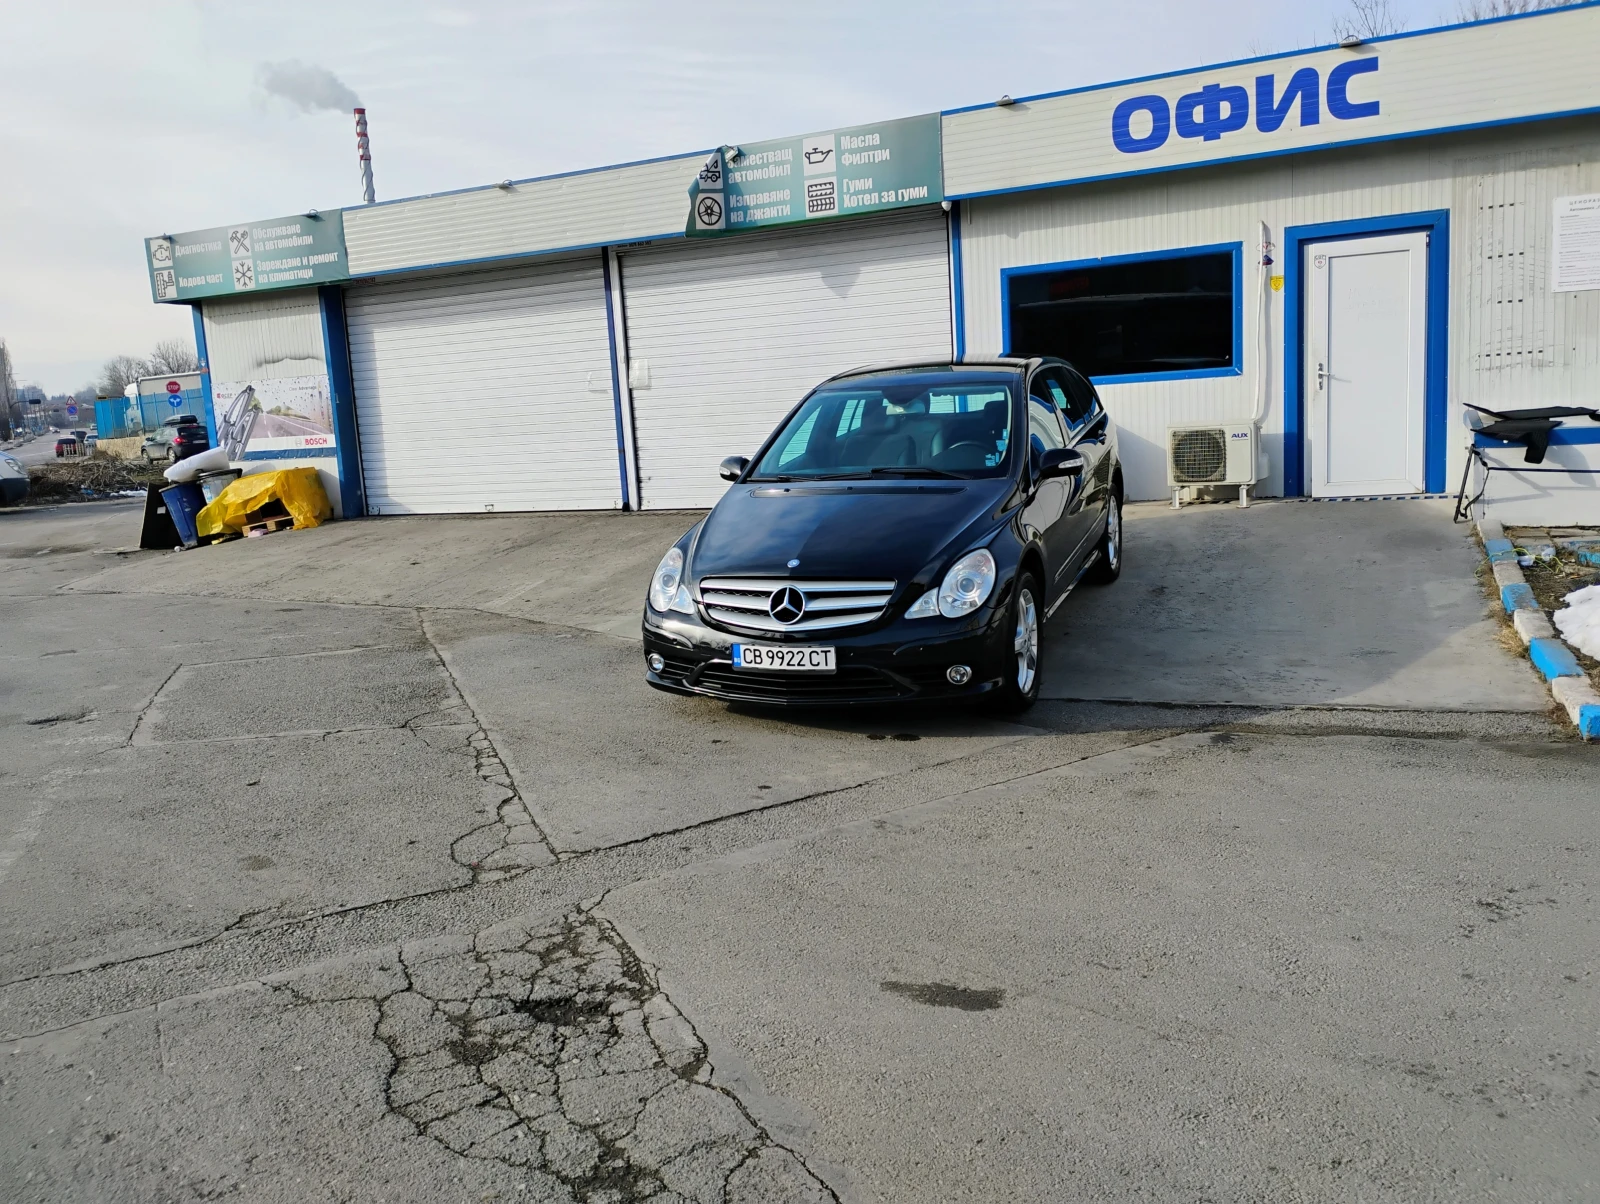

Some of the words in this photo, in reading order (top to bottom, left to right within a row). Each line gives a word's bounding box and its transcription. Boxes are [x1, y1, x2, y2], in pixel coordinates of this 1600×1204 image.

[1112, 56, 1380, 154] ОФИС
[840, 133, 880, 150] Масла
[841, 147, 890, 167] Филтри
[728, 163, 791, 184] автомобил
[842, 177, 873, 193] Гуми
[729, 188, 791, 208] Изправяне
[843, 192, 879, 208] Хотел
[881, 191, 896, 204] за
[897, 186, 928, 202] гуми
[730, 210, 745, 223] на
[746, 204, 791, 222] джанти
[253, 224, 301, 239] Обслужване
[175, 241, 222, 257] Диагностика
[254, 242, 263, 252] на
[264, 234, 313, 250] автомобили
[256, 257, 301, 272] Зареждане
[302, 257, 308, 266] и
[308, 251, 339, 267] ремонт
[178, 274, 206, 288] Ходова
[206, 272, 223, 284] част
[258, 273, 268, 284] на
[268, 268, 314, 283] климатици
[304, 437, 328, 446] BOSCH
[743, 648, 763, 664] CB
[766, 649, 806, 667] 9922
[809, 650, 831, 667] CT
